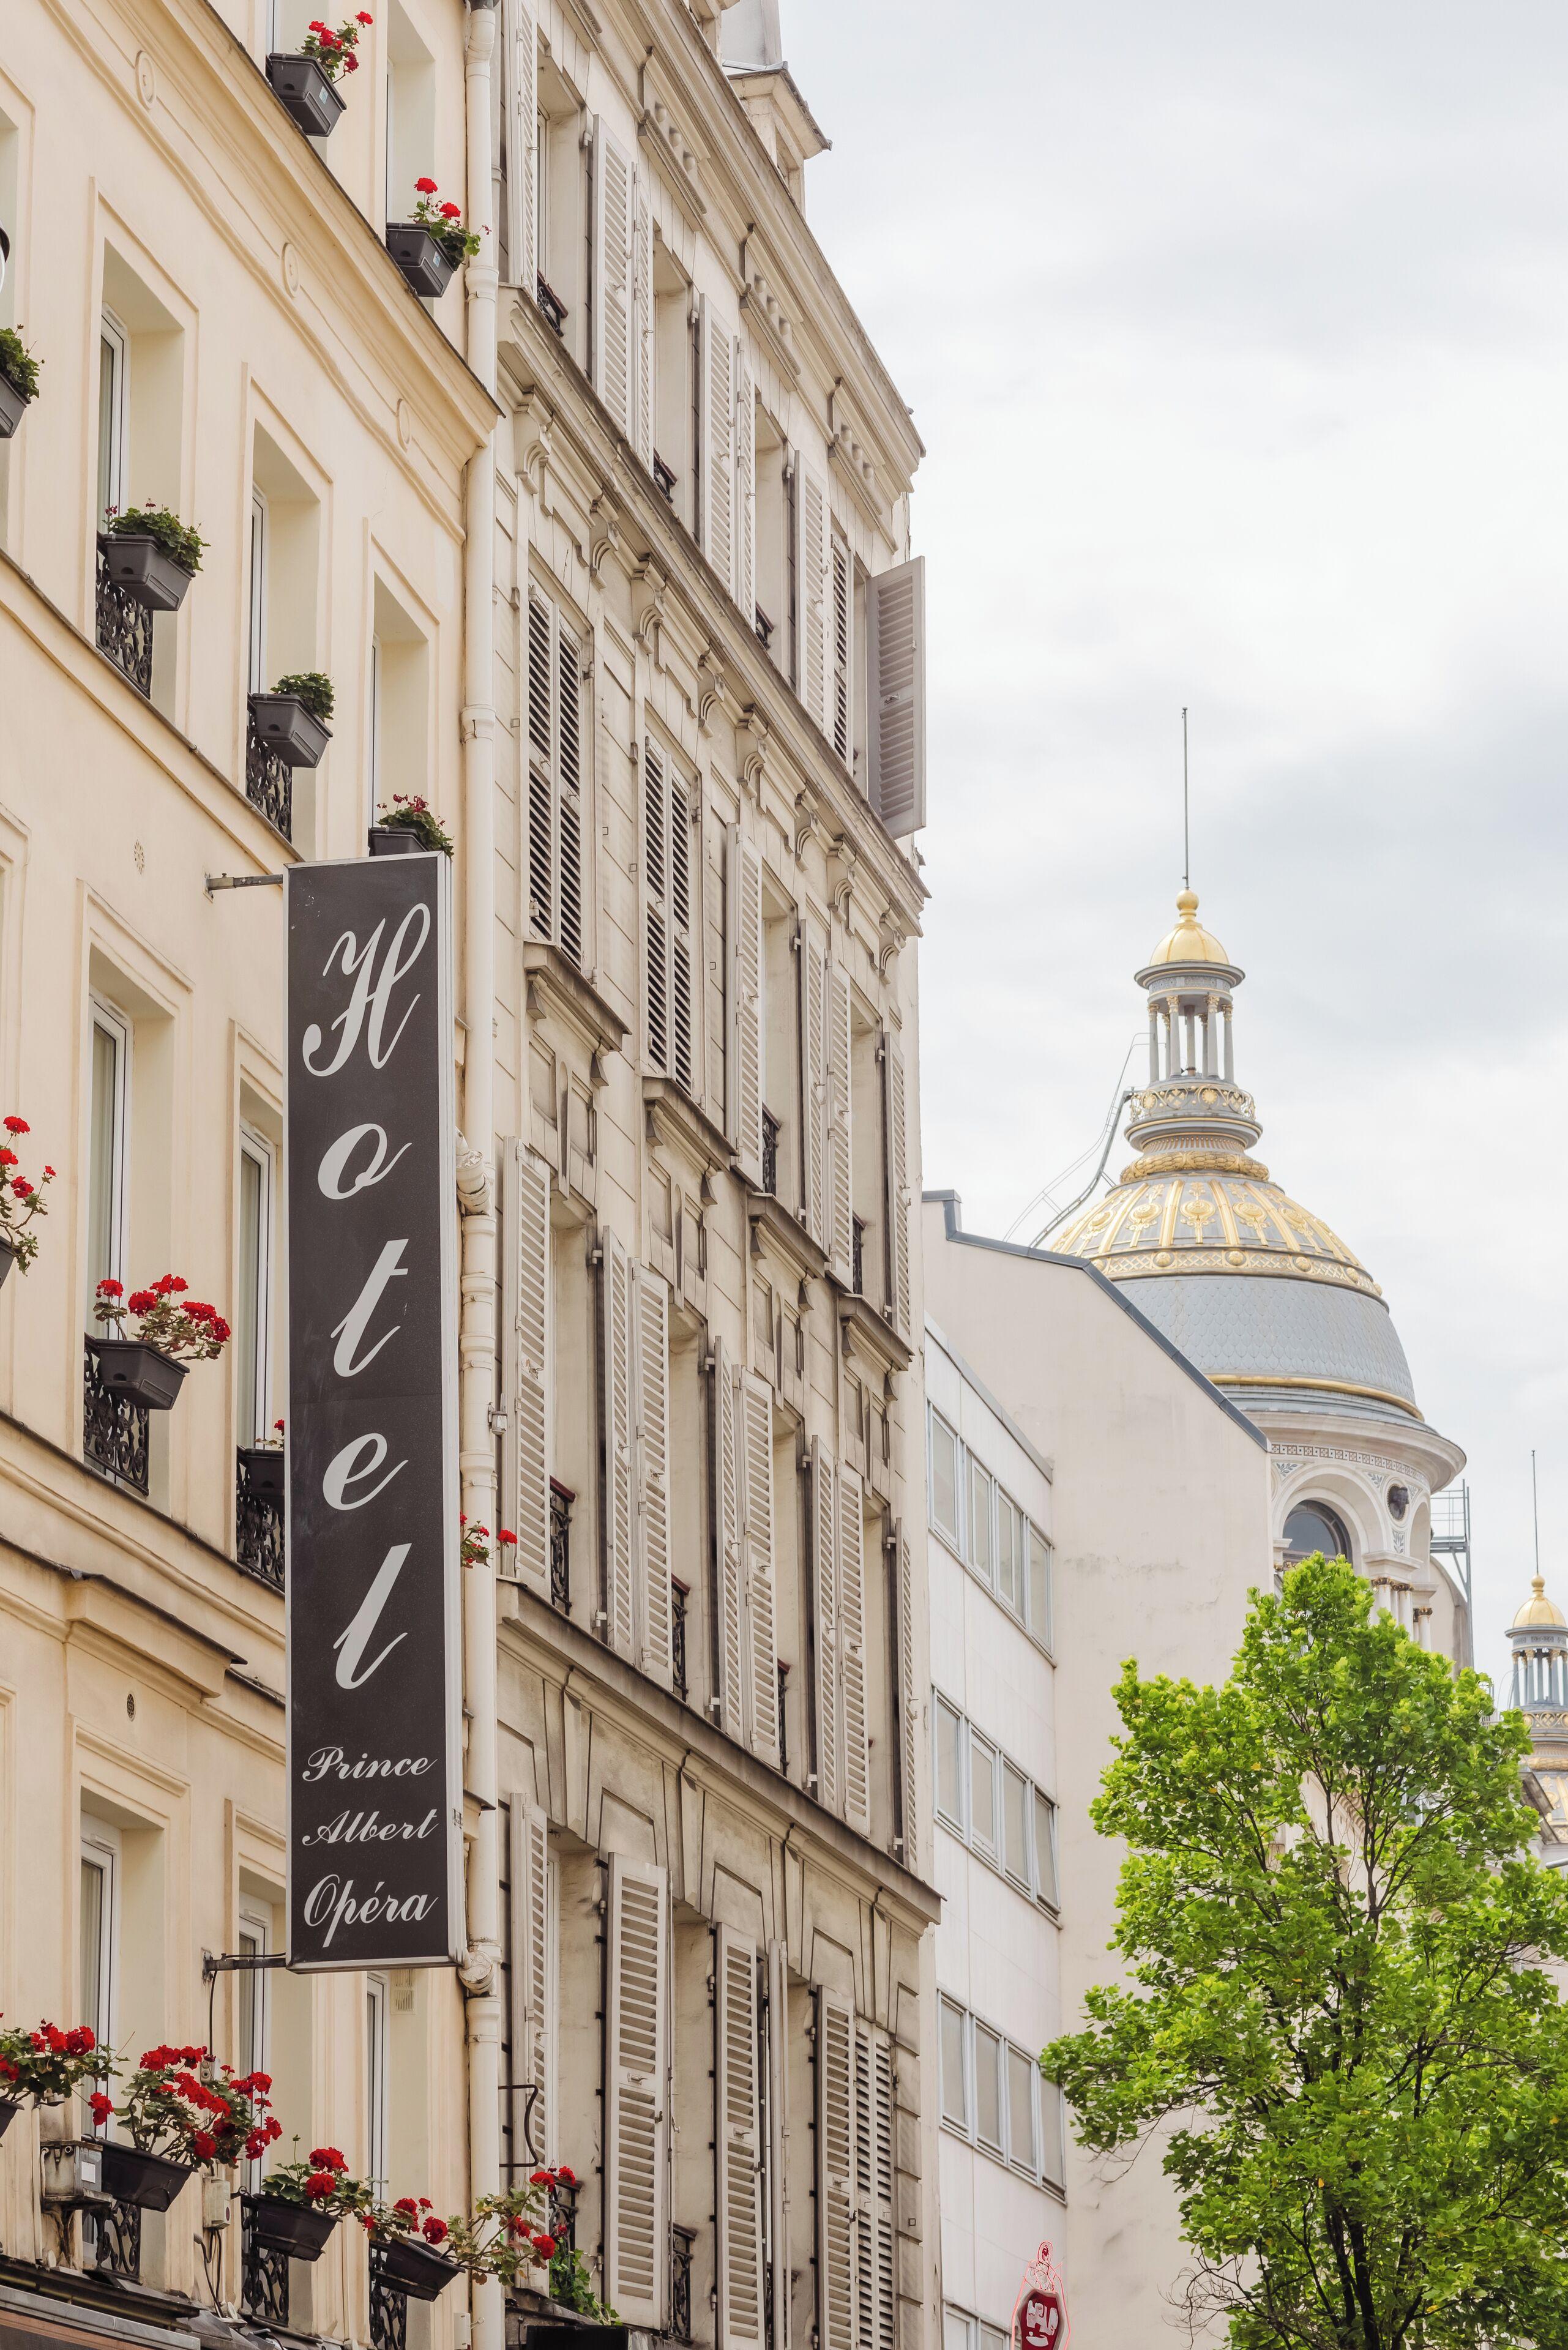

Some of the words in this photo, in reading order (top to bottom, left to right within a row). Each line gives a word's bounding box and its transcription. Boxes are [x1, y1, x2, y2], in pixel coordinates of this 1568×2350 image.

[302, 903, 431, 1690] Hotel
[302, 1747, 438, 1781] Prince
[302, 1809, 439, 1846] Albert
[304, 1874, 439, 1948] Opéra
